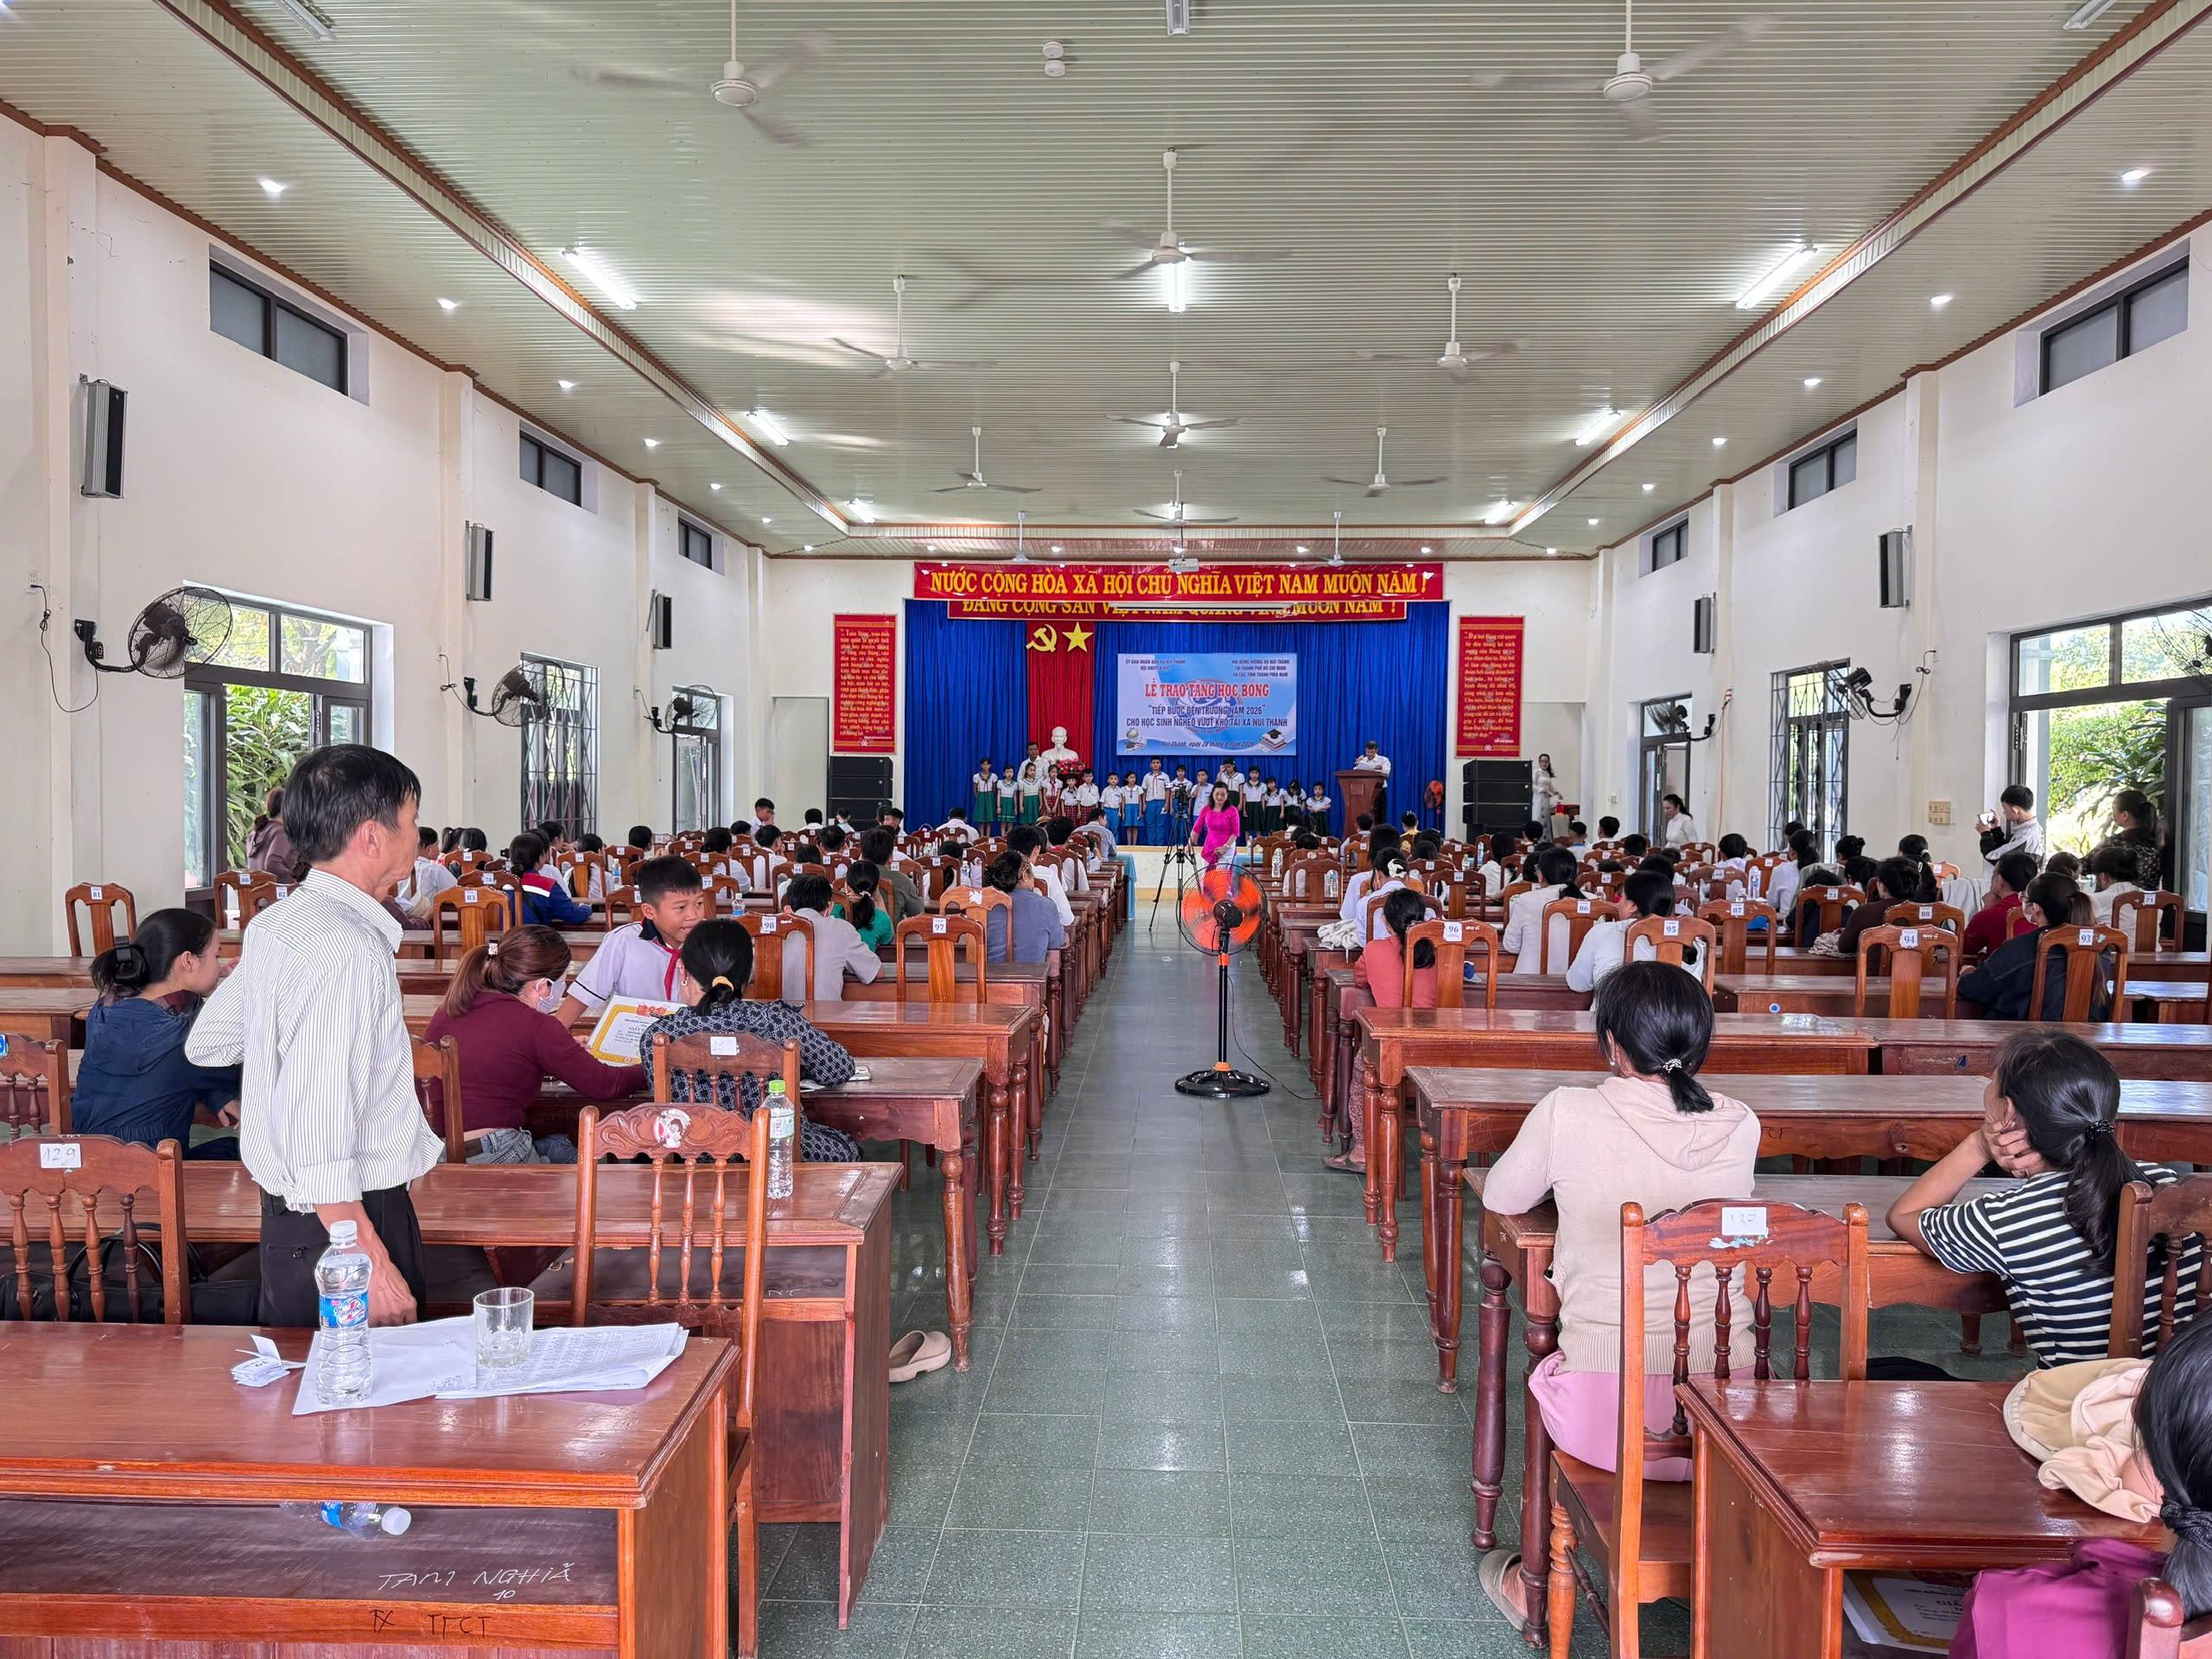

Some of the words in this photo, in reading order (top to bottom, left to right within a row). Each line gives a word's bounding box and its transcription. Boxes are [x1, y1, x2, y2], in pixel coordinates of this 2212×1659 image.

[931, 567, 977, 594] NƯỚC
[982, 569, 1027, 597] CỘNG
[1031, 569, 1068, 594] HÒA
[1072, 571, 1098, 594] XÃ
[1103, 570, 1134, 598] HỘI
[1136, 568, 1173, 594] CHỦ
[1176, 570, 1233, 594] NGHĨA
[1234, 571, 1275, 598] VIỆT
[1279, 574, 1319, 594] NAM
[1323, 570, 1373, 594] MUÔN
[1376, 571, 1417, 594] NĂM
[1160, 683, 1186, 697] TRAO
[1218, 683, 1238, 701] HỌC
[1141, 718, 1154, 728] HỌC
[2081, 934, 2092, 943] 93
